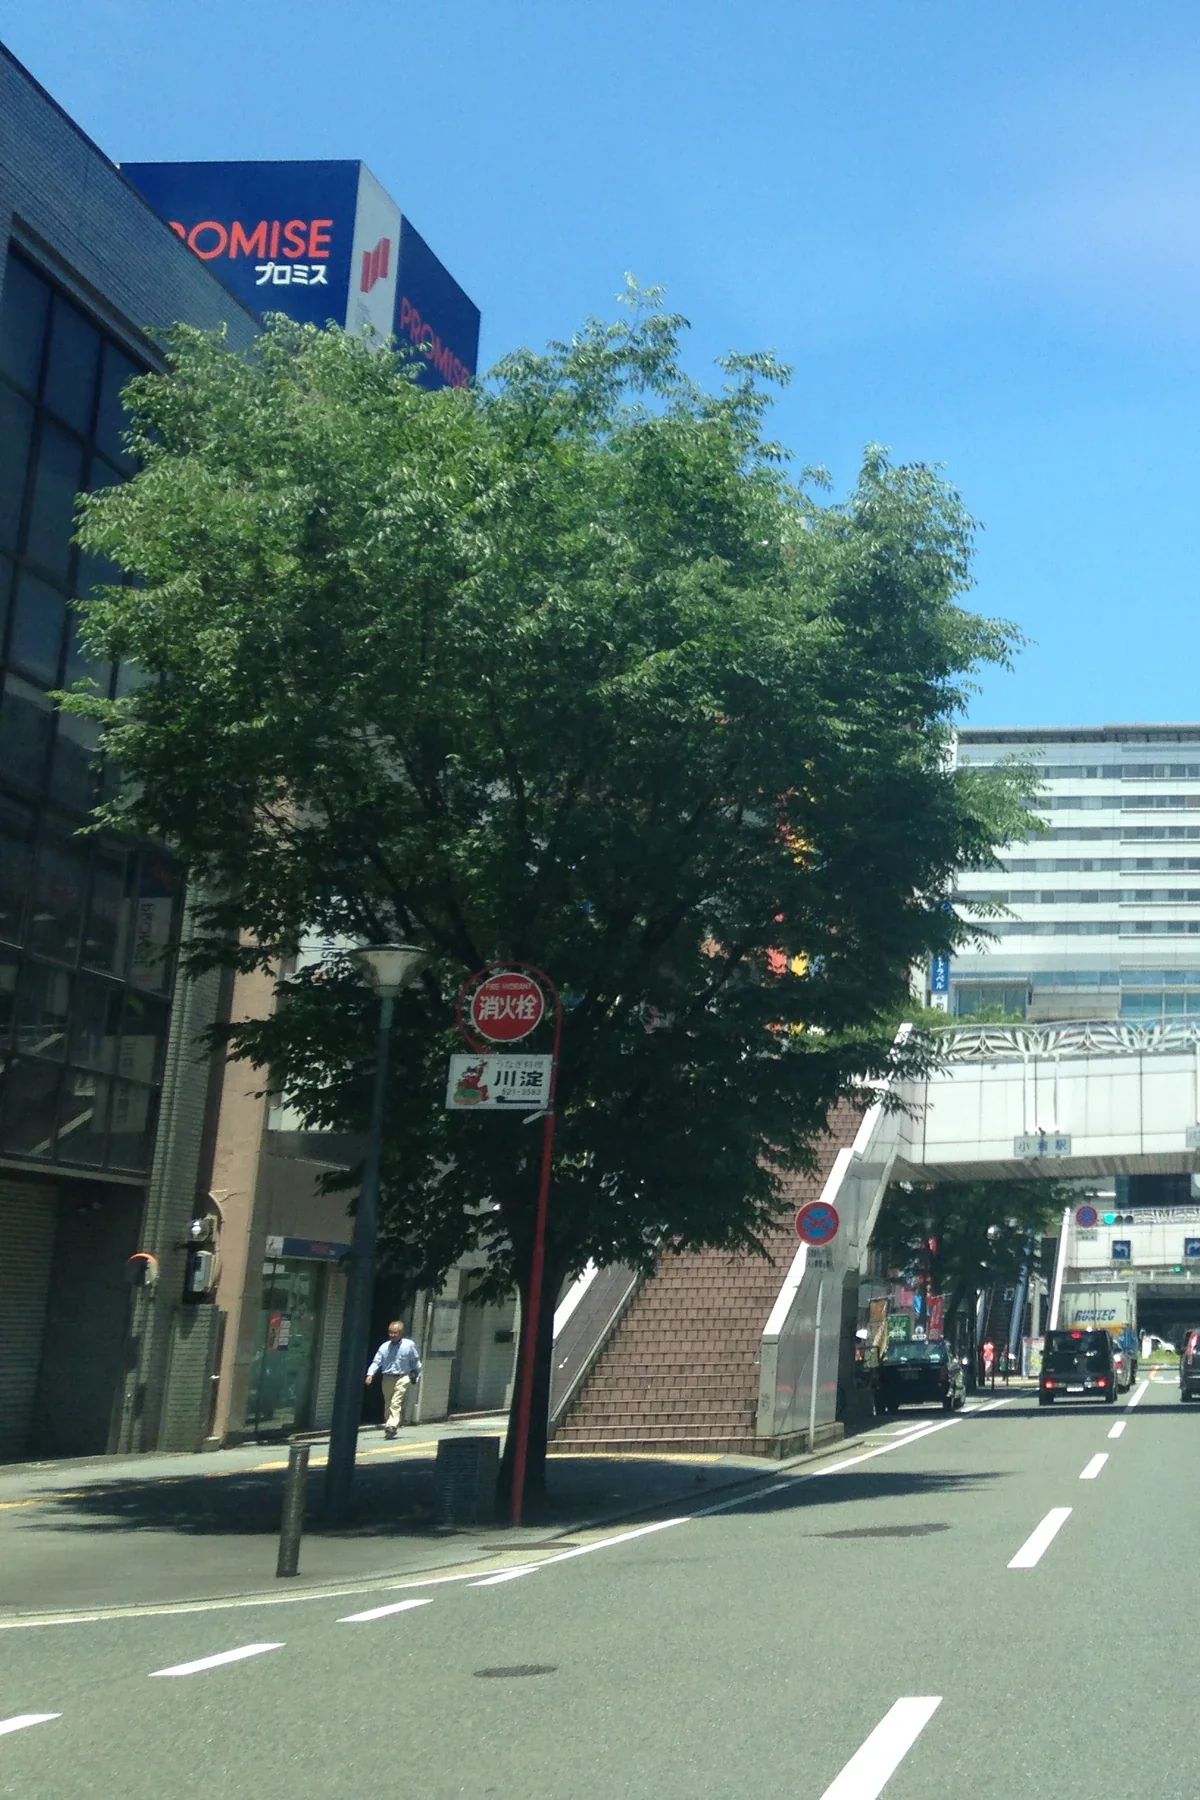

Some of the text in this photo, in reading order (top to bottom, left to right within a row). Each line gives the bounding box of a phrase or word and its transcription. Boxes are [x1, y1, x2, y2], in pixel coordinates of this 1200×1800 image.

[255, 261, 328, 286] プロミス
[478, 994, 538, 1021] 消火栓
[494, 1070, 544, 1087] 川淀
